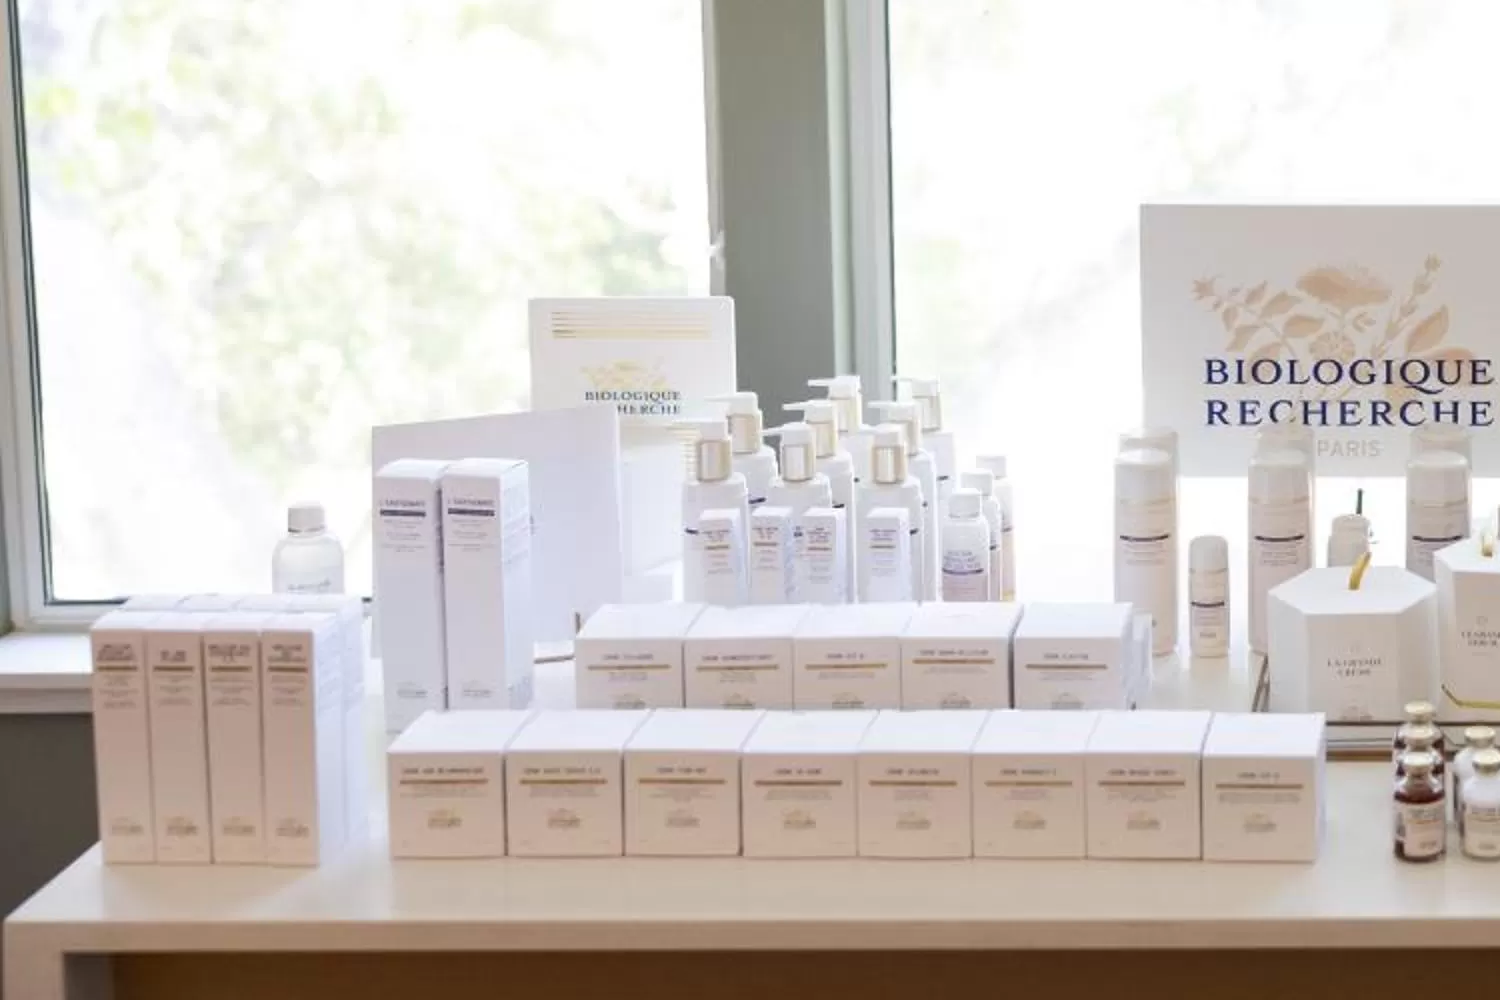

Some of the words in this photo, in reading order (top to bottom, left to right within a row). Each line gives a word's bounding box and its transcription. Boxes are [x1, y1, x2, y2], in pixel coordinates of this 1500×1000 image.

[1204, 358, 1495, 395] BIOLOGIQUE
[585, 391, 681, 404] BIOLOGIQUE
[617, 404, 681, 415] HERCHE
[1205, 399, 1495, 428] RECHERCHE
[1316, 439, 1382, 458] PARIS
